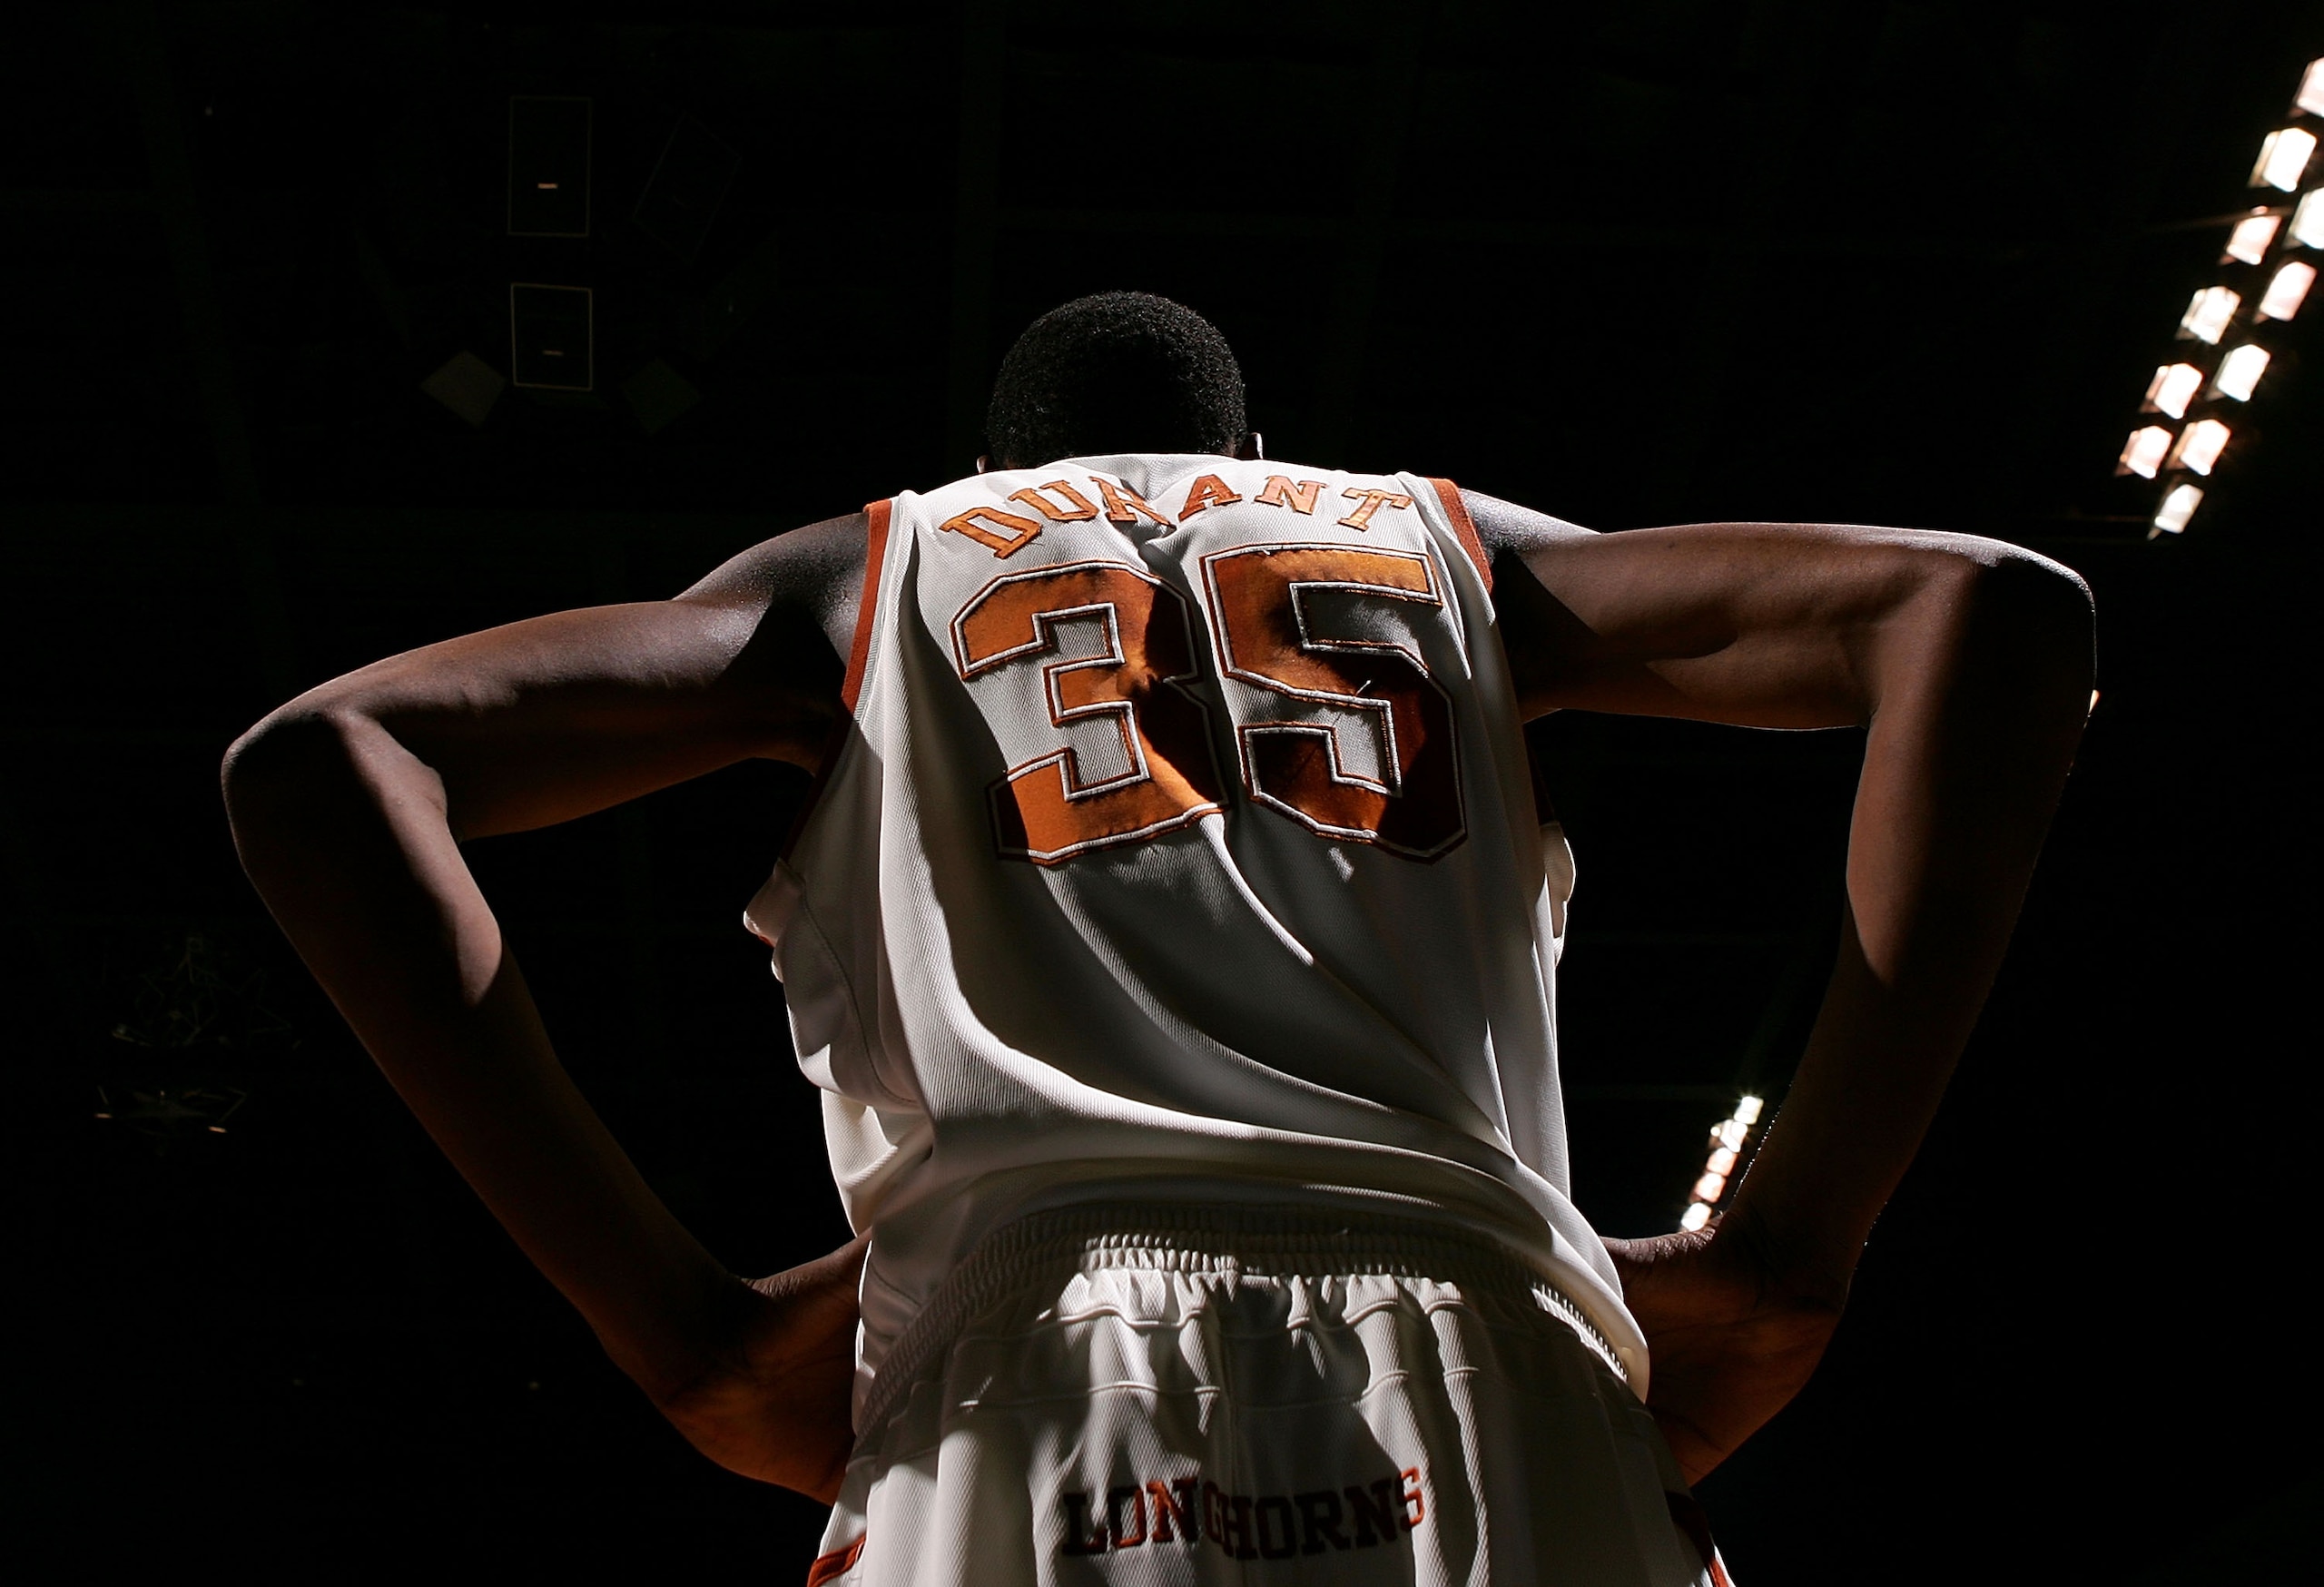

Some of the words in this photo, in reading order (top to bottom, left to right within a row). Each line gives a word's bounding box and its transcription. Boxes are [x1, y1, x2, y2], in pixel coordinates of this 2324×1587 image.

[940, 474, 1412, 559] DURANT
[951, 544, 1466, 864] 35
[1062, 1467, 1424, 1560] LONGHORNS
